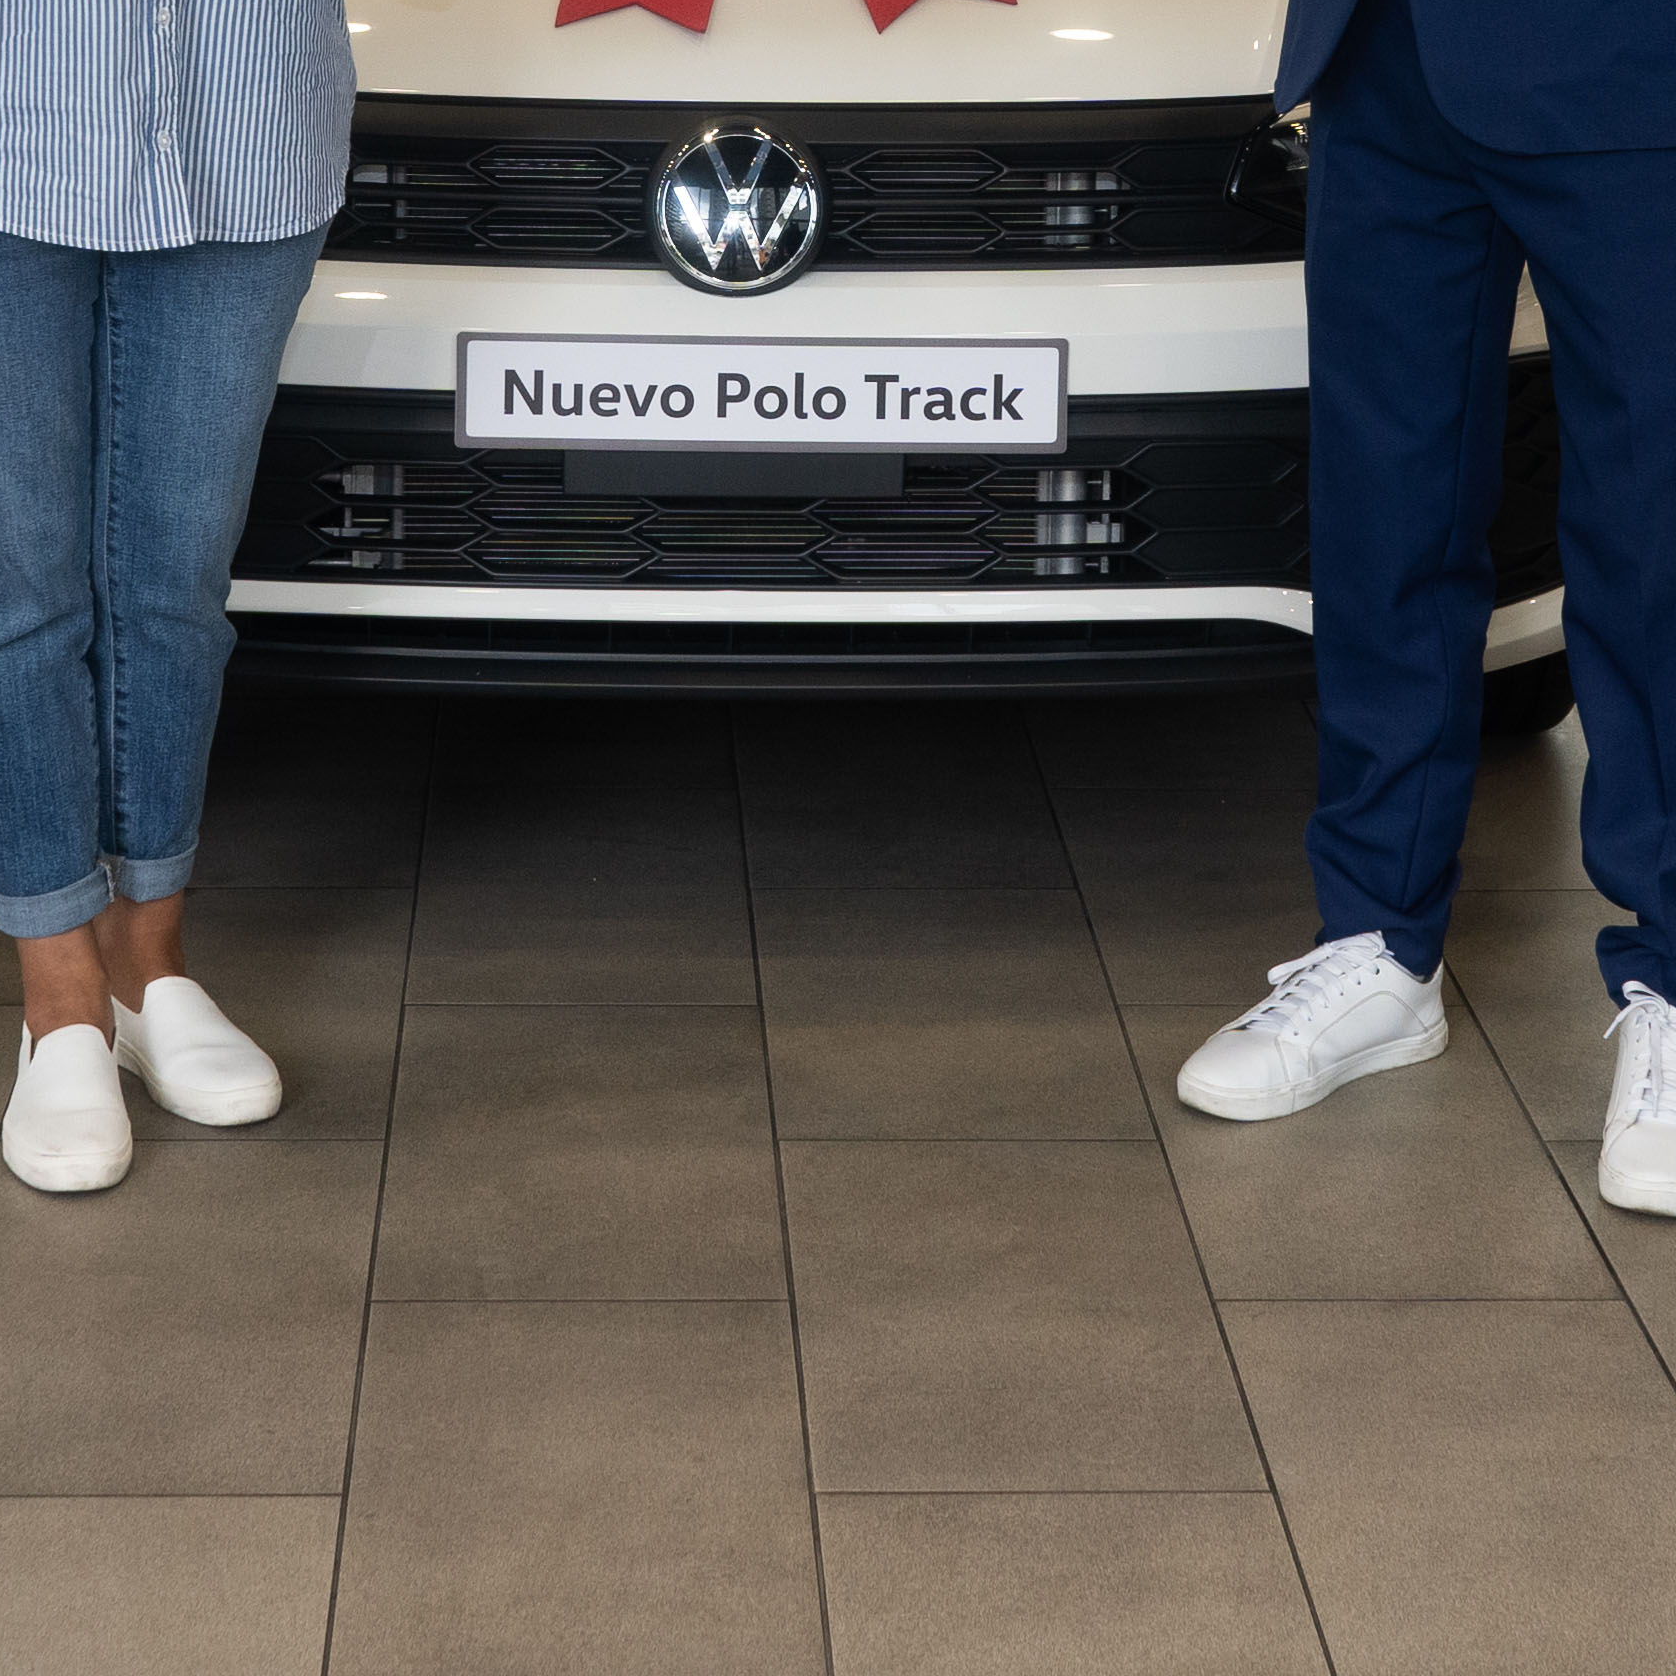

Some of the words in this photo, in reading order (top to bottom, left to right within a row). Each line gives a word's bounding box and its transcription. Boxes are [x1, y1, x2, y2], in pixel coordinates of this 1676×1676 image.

[666, 136, 812, 274] VW
[504, 369, 695, 419] Nuevo
[717, 373, 847, 420] Polo
[864, 374, 1024, 421] Track
